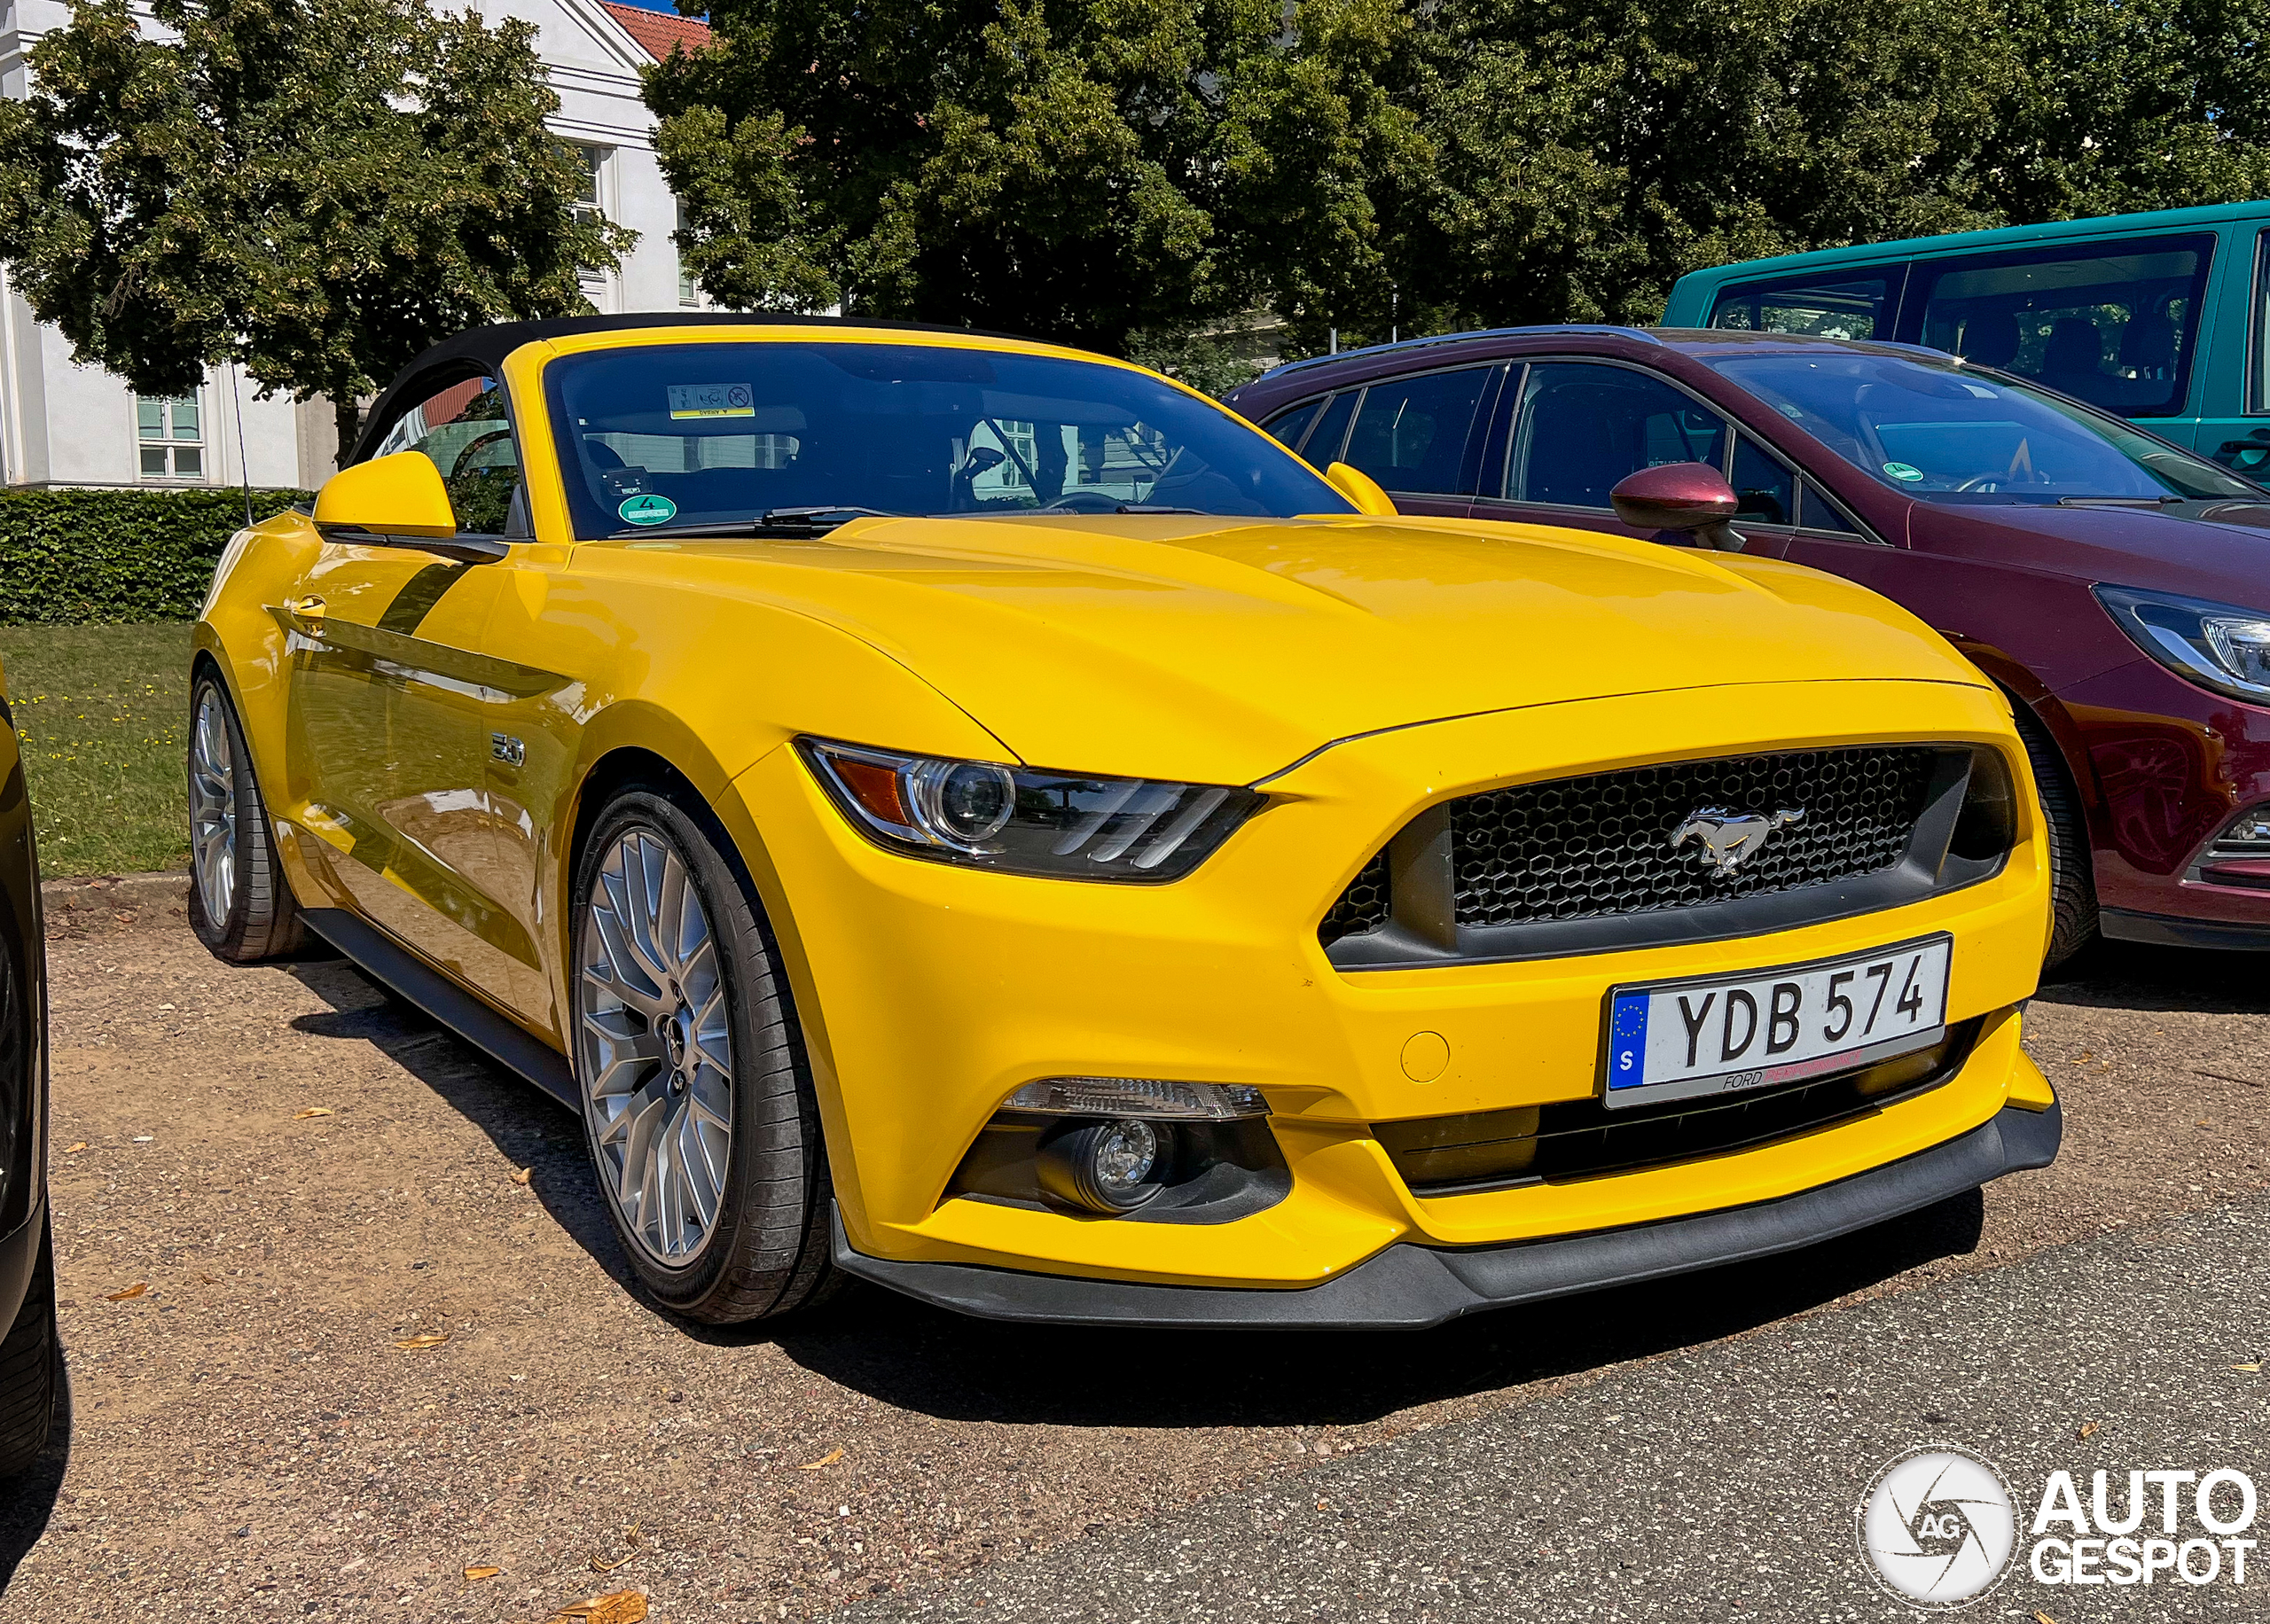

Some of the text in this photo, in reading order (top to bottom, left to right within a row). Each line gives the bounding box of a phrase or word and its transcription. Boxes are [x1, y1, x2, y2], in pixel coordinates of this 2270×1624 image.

[639, 497, 655, 509] 4
[1678, 954, 1923, 1068] YDB 574
[1620, 1050, 1634, 1071] S
[1723, 1071, 1763, 1089] FORD
